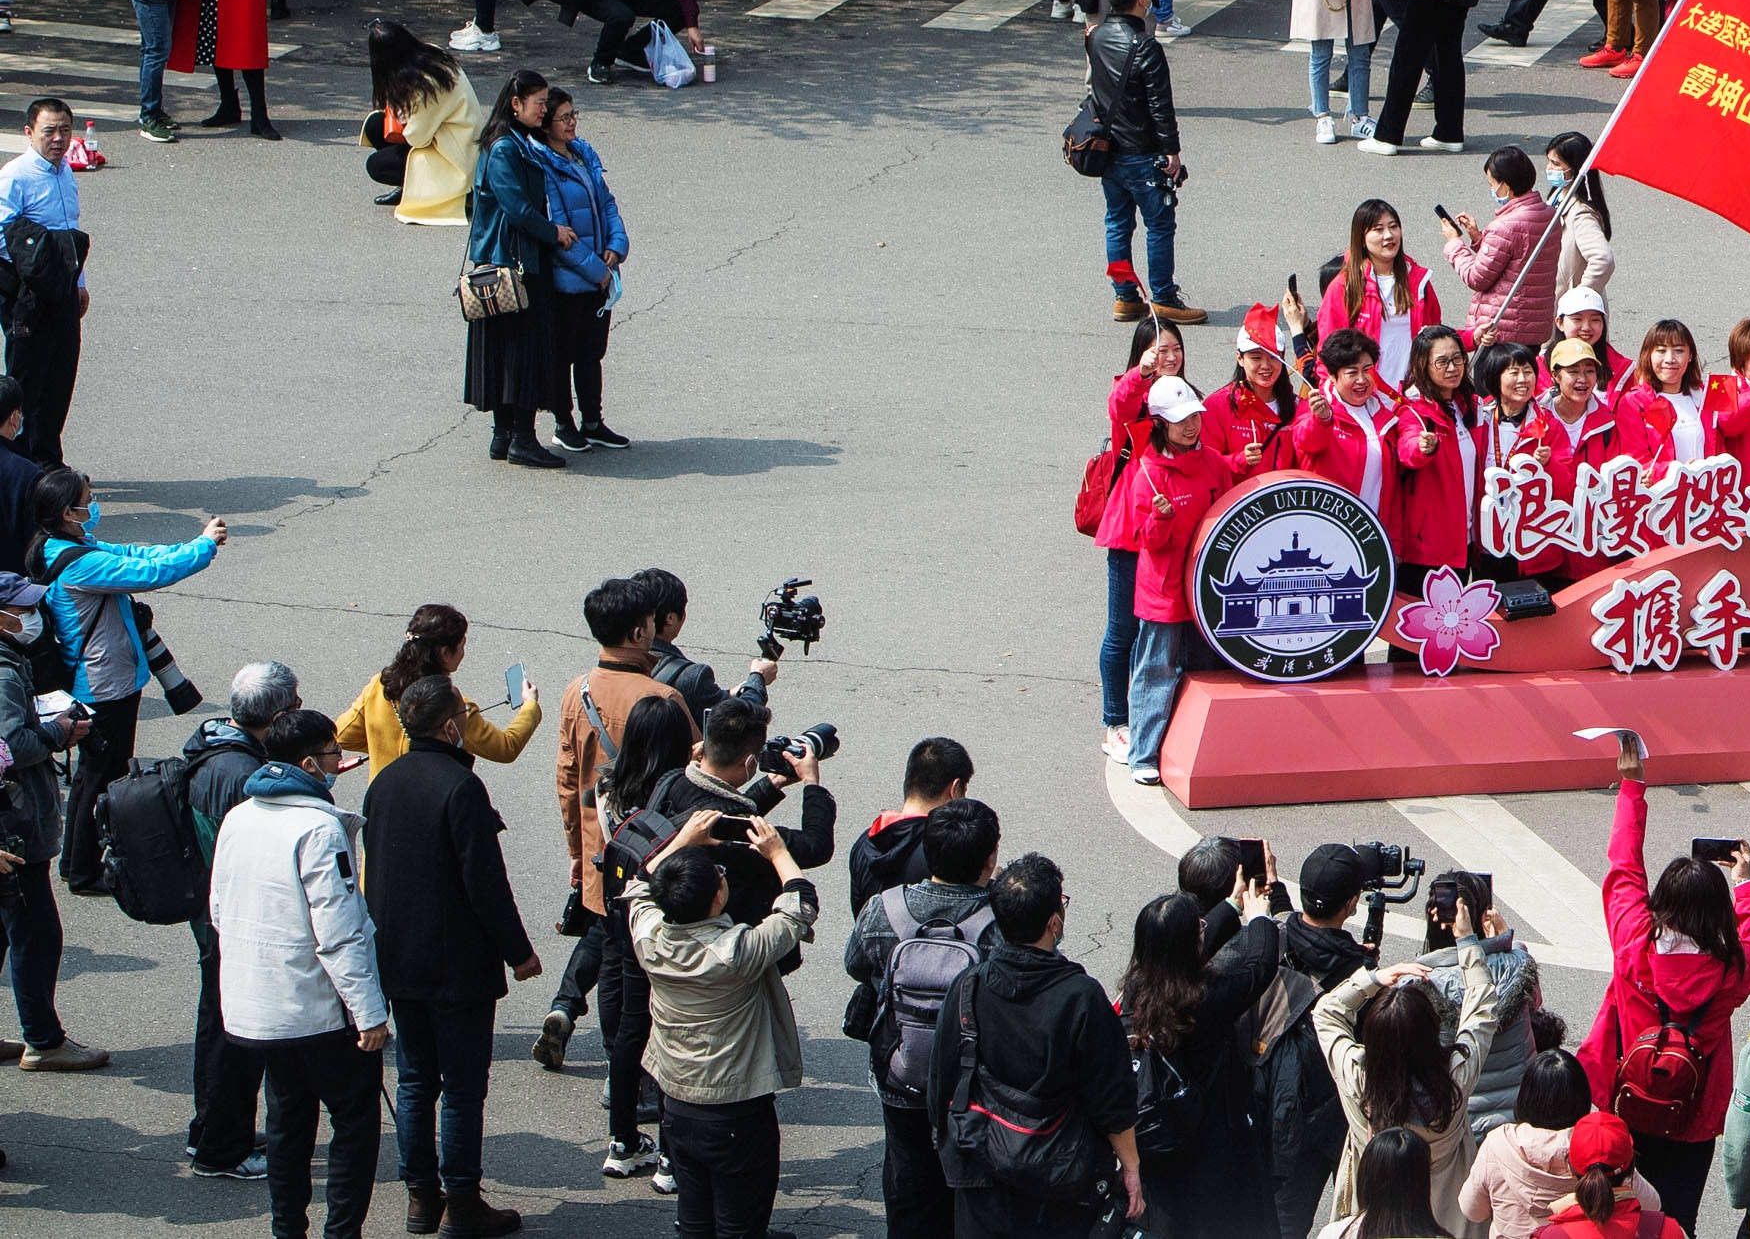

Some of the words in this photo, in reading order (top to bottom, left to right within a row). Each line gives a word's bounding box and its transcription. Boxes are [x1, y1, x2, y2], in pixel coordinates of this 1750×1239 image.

[1216, 501, 1265, 553] WUHAN
[1274, 490, 1379, 545] UNIVERSITY
[1276, 635, 1315, 646] 1893
